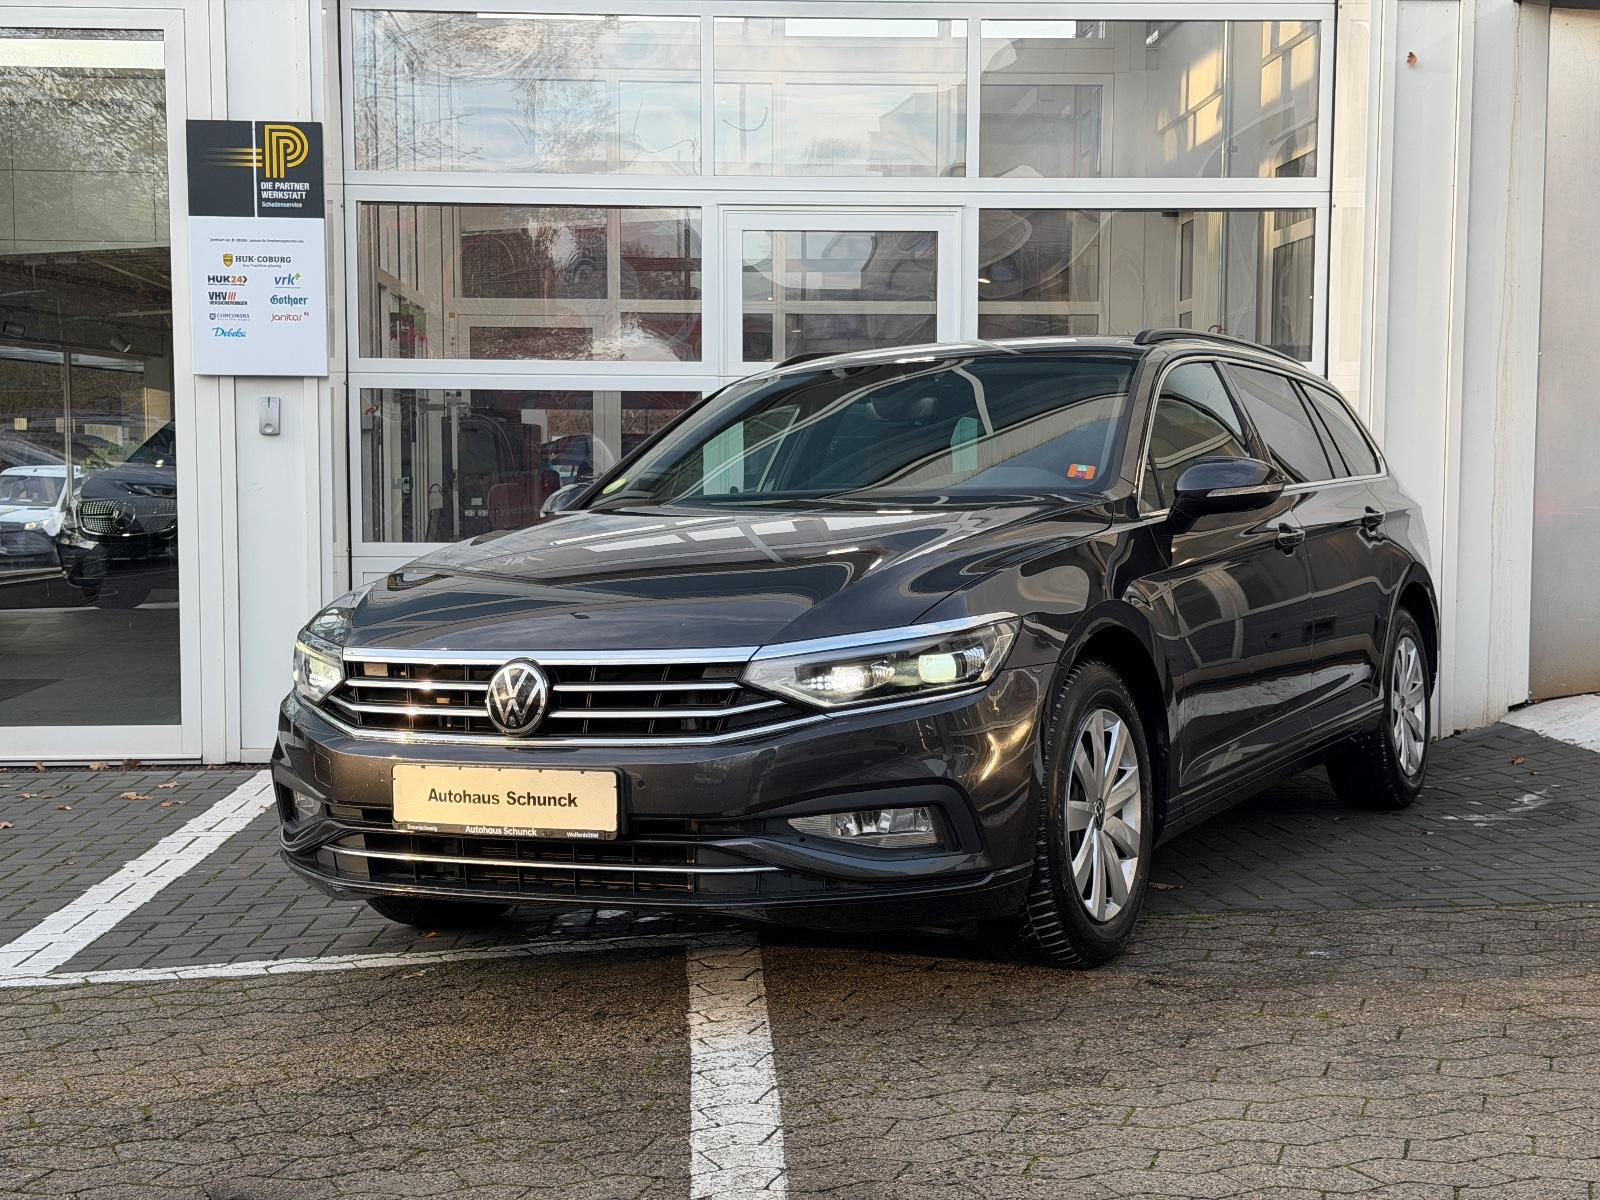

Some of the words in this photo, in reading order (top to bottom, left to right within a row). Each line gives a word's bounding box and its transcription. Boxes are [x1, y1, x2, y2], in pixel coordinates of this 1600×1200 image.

[260, 181, 273, 190] DIE
[274, 182, 310, 191] PARTNER
[261, 190, 306, 200] WERKSTATT
[261, 201, 302, 209] Schadenservice
[235, 255, 292, 264] HUK-COBURG
[207, 275, 243, 284] HUK24
[208, 291, 228, 301] VHV
[270, 294, 308, 307] Gothaer
[212, 326, 246, 338] Debeka
[428, 788, 500, 805] Autohaus
[506, 790, 578, 808] Schunck
[465, 825, 502, 835] Autohaus
[503, 827, 537, 837] Schunck
